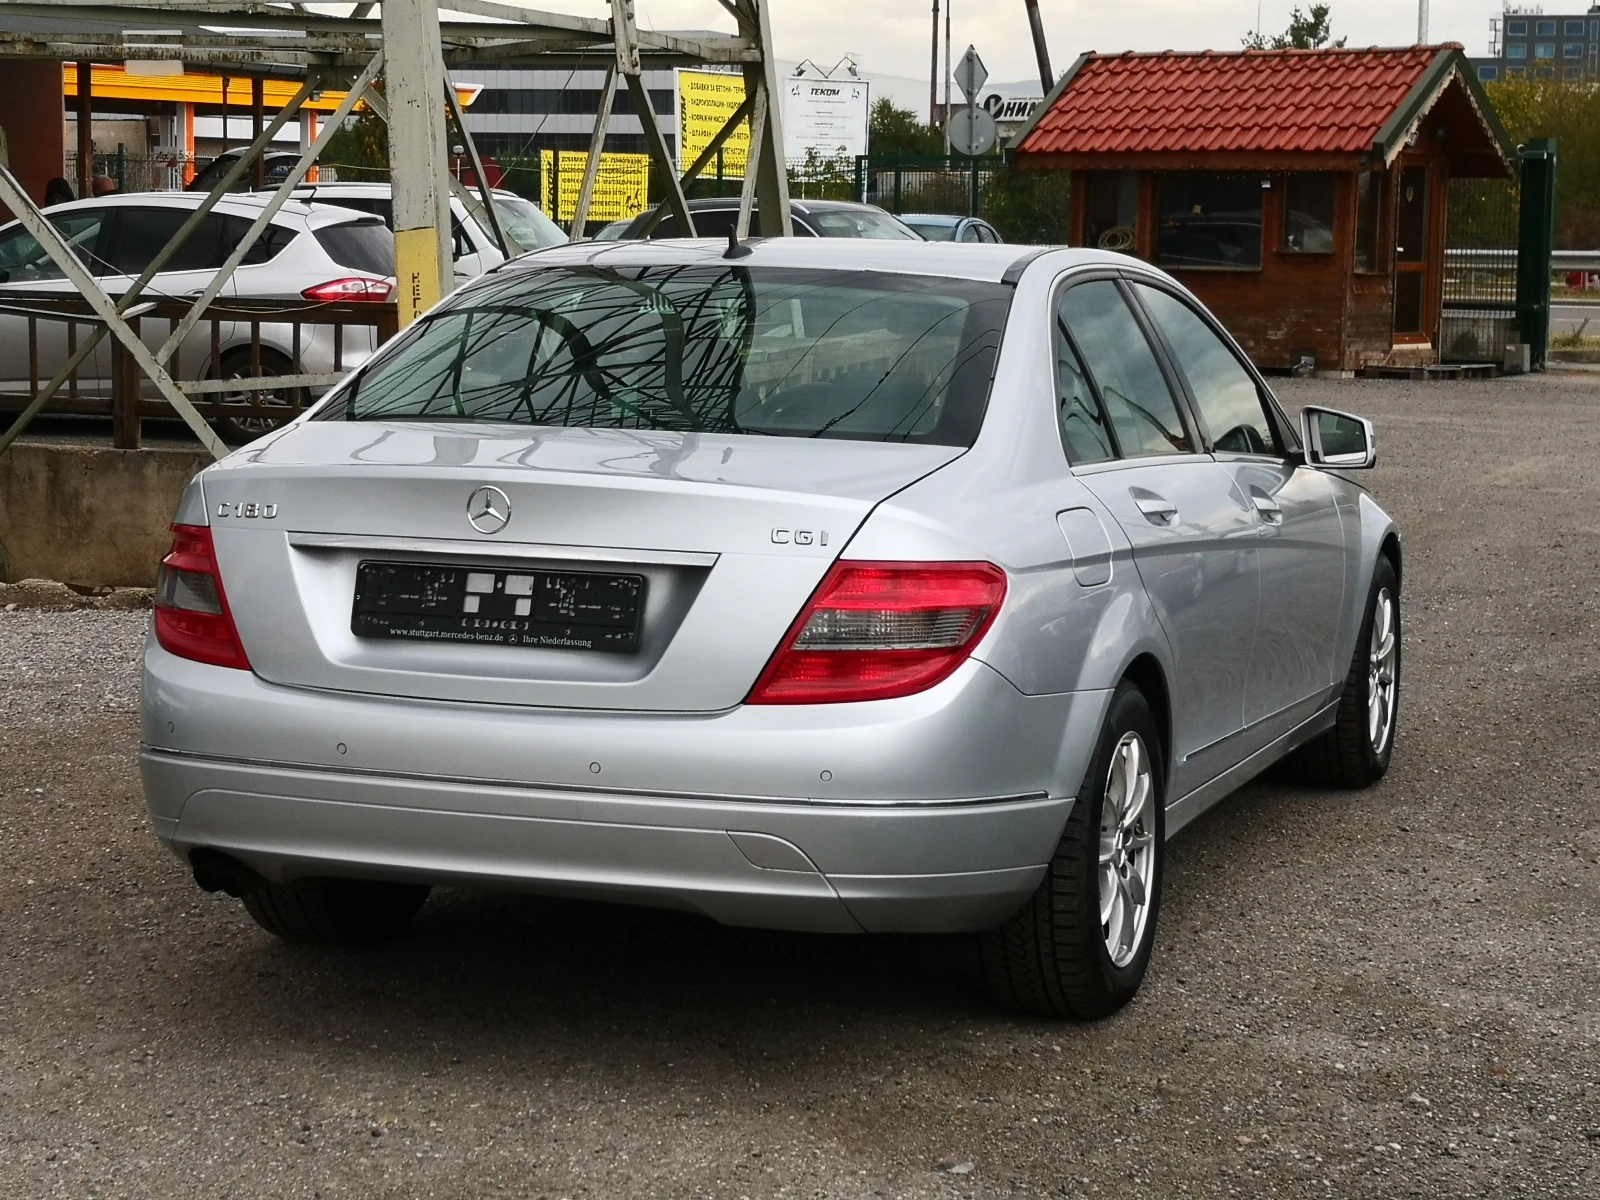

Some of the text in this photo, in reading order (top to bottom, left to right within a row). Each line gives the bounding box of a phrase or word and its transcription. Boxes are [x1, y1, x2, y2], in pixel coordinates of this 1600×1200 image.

[810, 88, 840, 96] ТЕКОМ
[217, 502, 278, 519] C180
[771, 527, 829, 547] CGI
[389, 627, 592, 648] www.stuttgart.mercedes-benz.de Ihre Niederlassung
